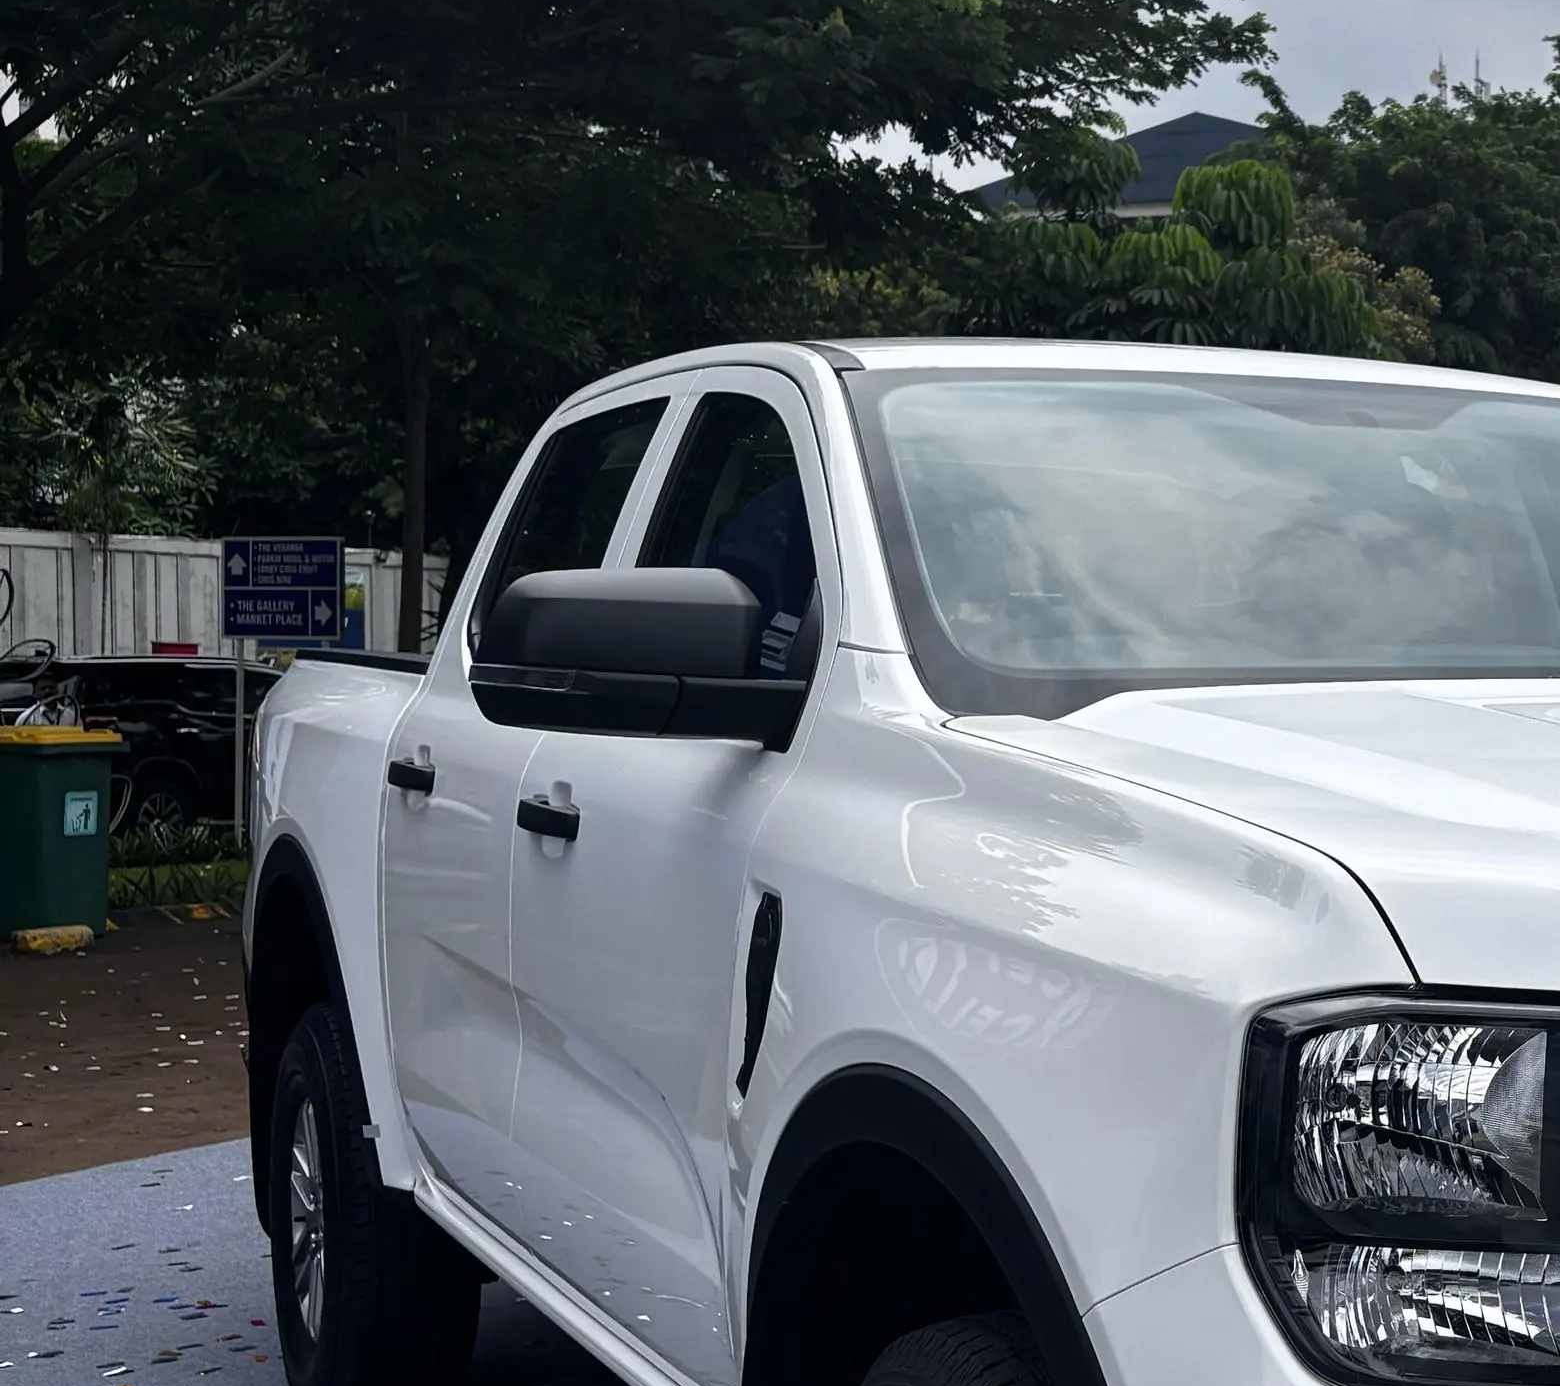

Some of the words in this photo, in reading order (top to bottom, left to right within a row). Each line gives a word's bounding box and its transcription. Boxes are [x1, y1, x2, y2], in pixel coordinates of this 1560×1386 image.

[237, 599, 255, 612] THE
[256, 599, 294, 612] GALLERY
[236, 613, 273, 626] MARKET
[275, 613, 304, 626] PLACE
